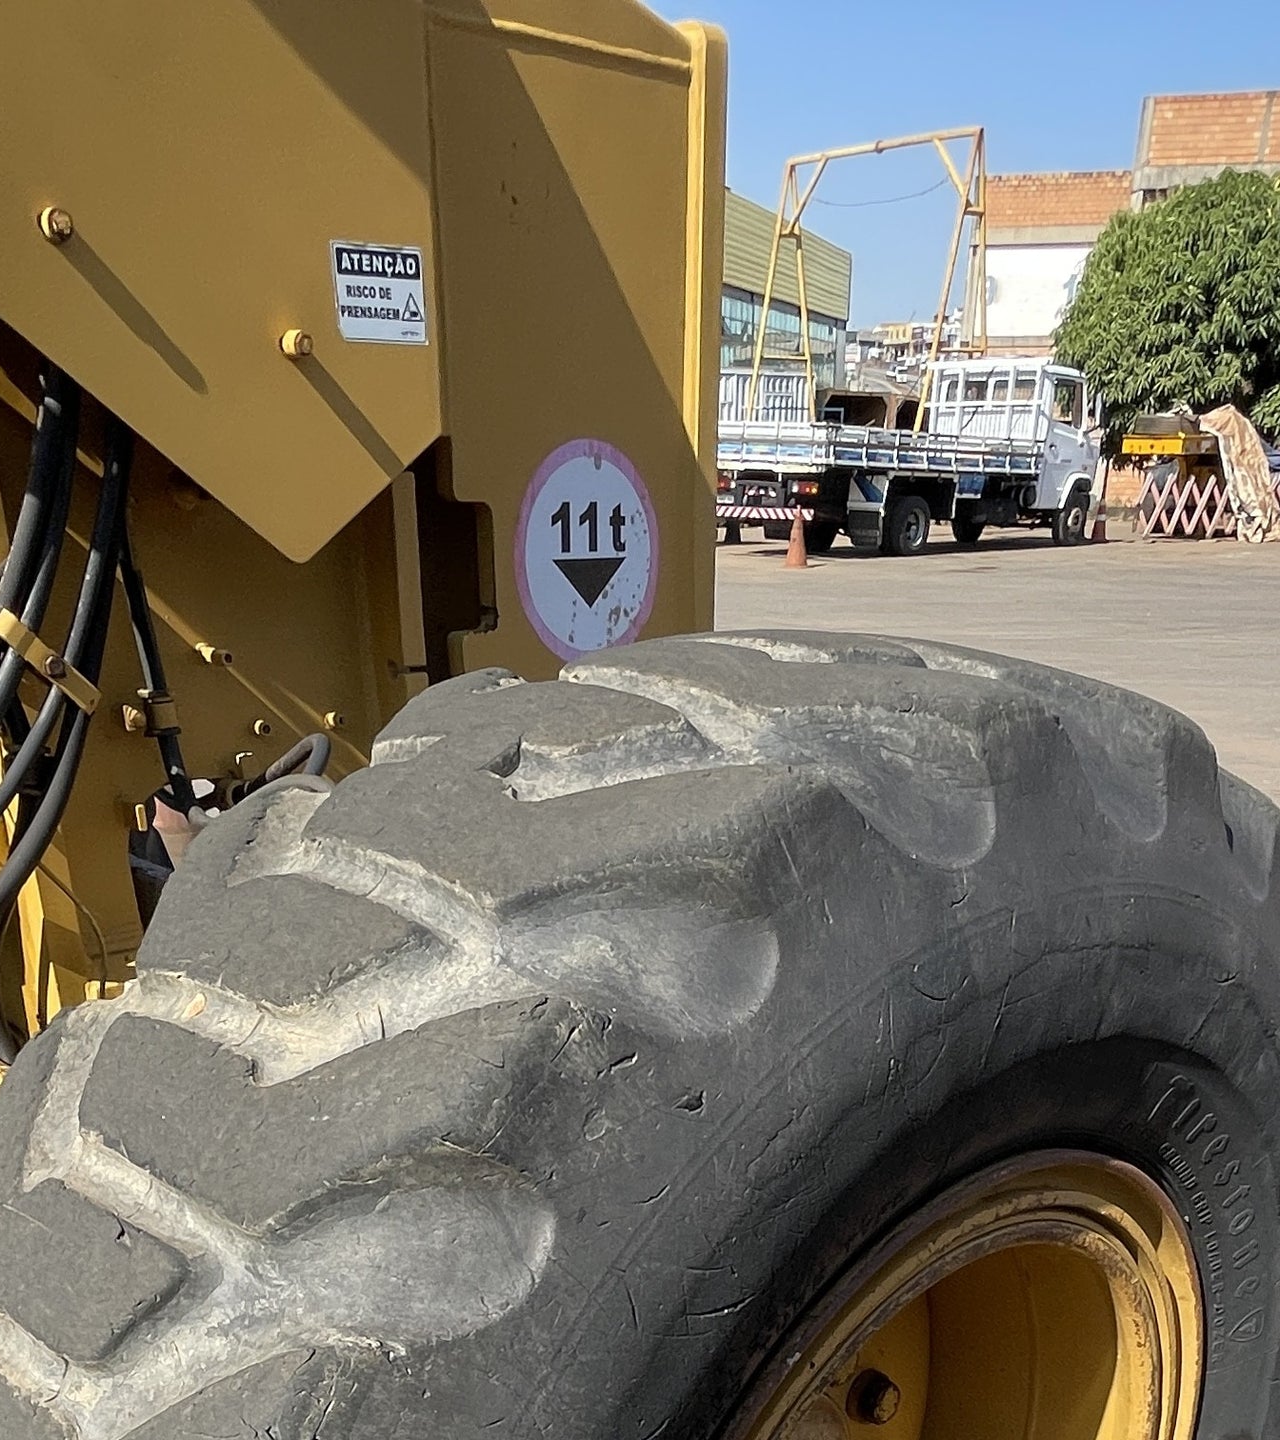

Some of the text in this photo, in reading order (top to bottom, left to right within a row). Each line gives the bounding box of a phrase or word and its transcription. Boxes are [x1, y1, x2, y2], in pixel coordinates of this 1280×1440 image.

[341, 252, 416, 277] ATENÇÃO
[346, 285, 392, 300] RISCO DE
[341, 305, 400, 320] PRENSAGEM
[551, 501, 625, 553] 11t
[1191, 1191, 1213, 1225] GRIP
